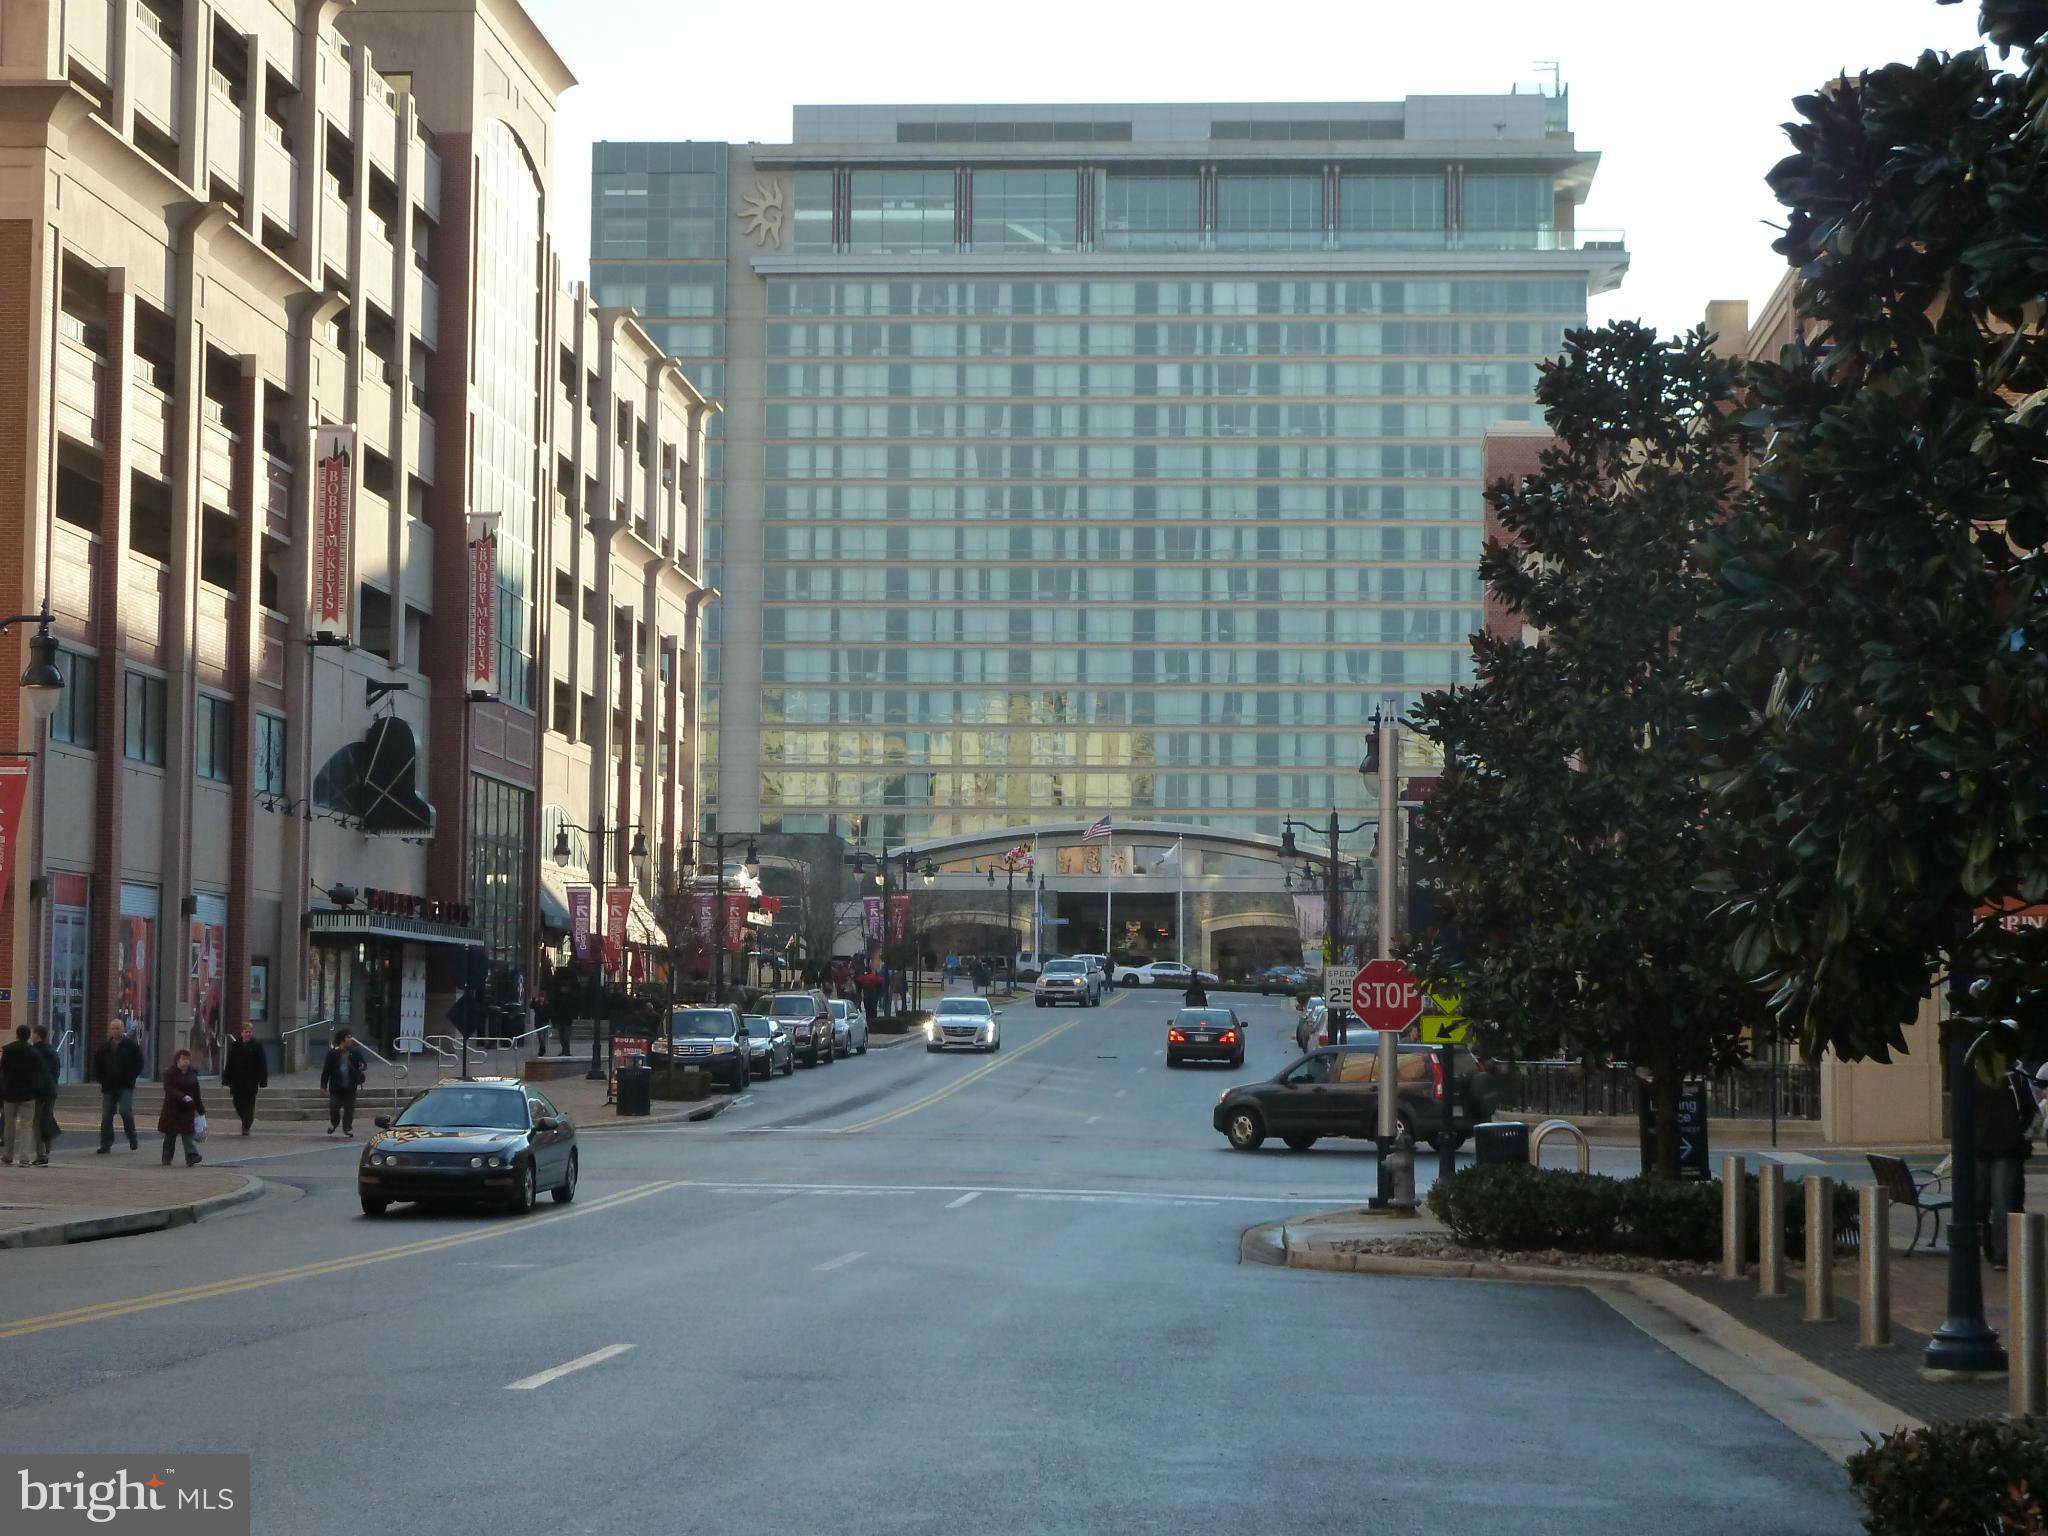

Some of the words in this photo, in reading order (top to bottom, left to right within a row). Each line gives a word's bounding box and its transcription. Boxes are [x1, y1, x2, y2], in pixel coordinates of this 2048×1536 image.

[327, 470, 339, 532] BOBBY
[477, 551, 489, 604] BOBBY
[1329, 987, 1352, 1003] 25
[1356, 982, 1419, 1009] STOP
[1649, 1099, 1697, 1113] Ling
